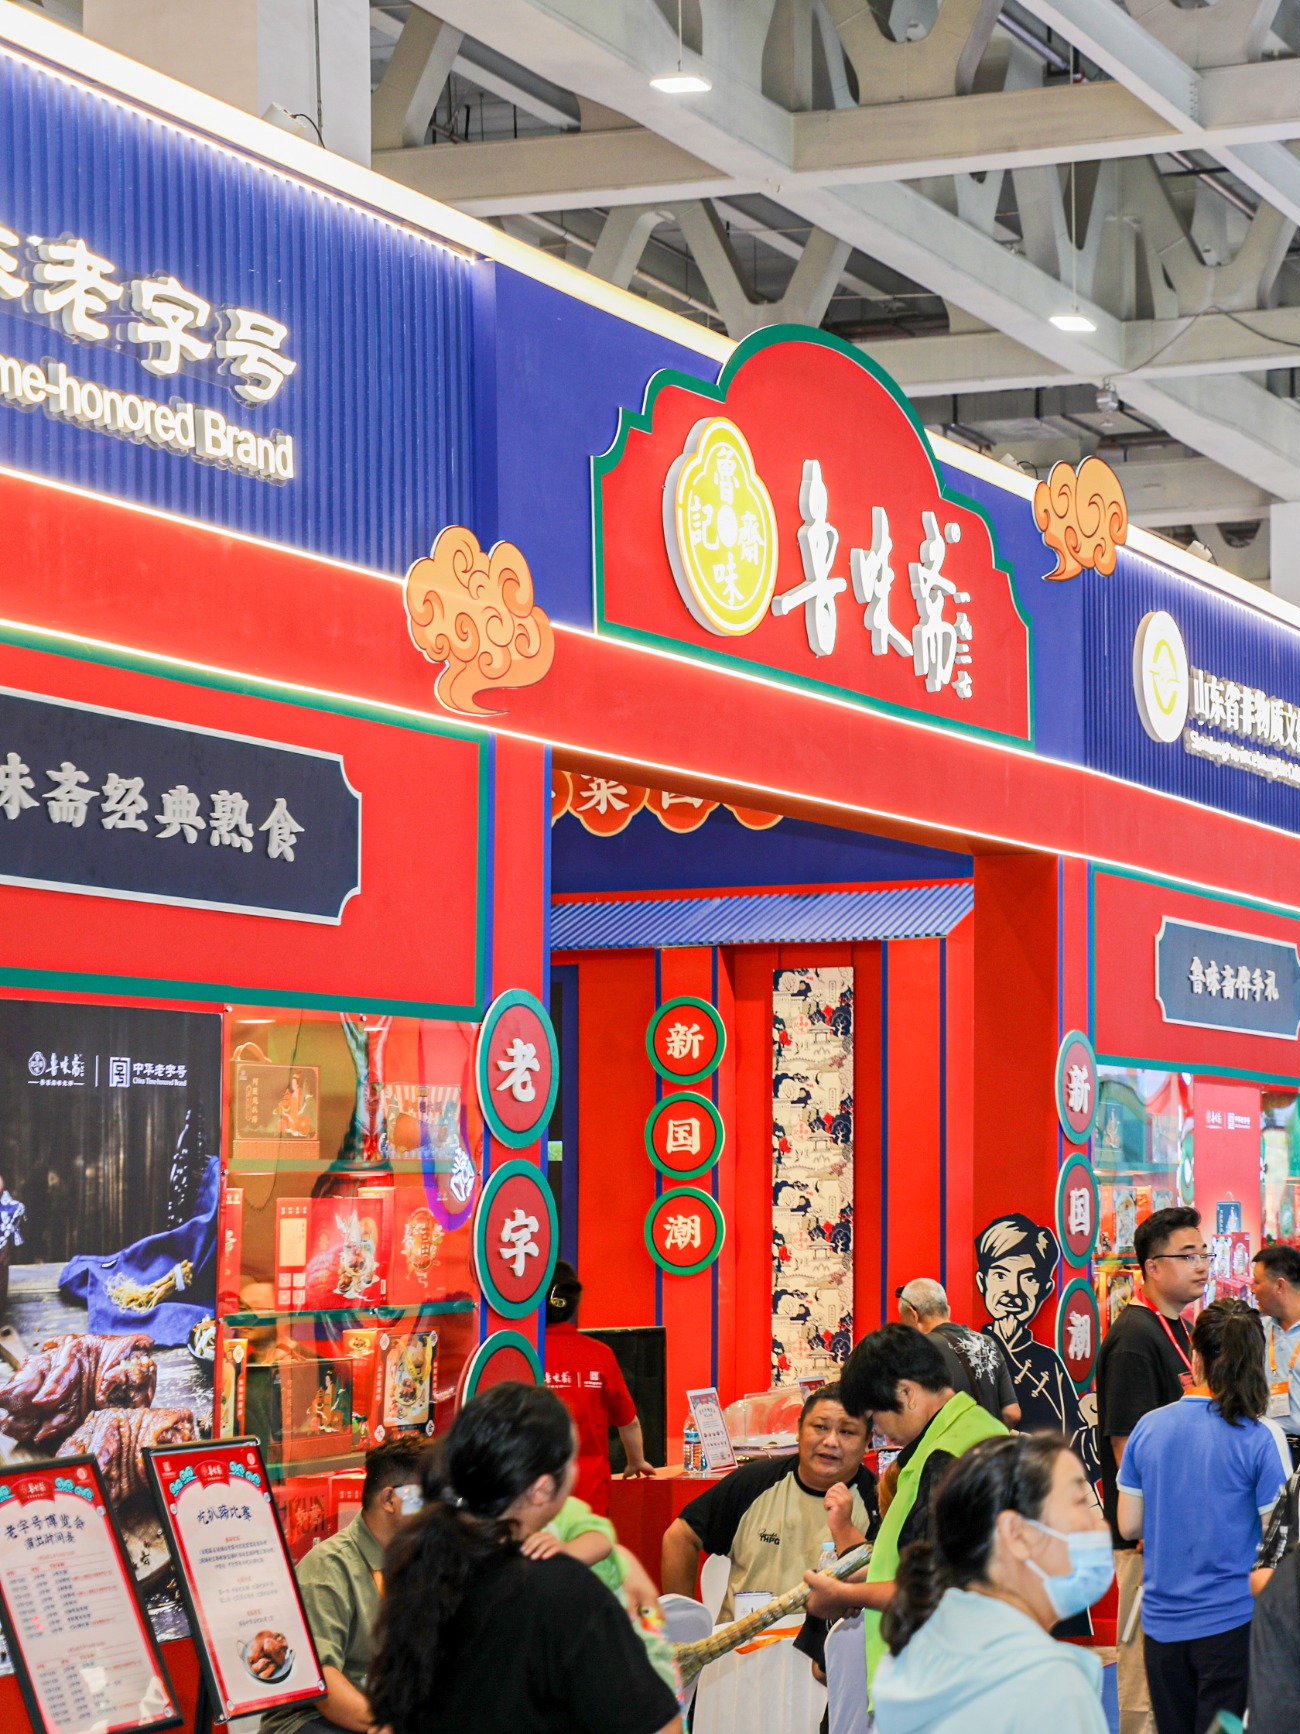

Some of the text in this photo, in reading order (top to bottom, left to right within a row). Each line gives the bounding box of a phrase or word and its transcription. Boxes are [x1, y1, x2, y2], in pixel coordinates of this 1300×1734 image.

[203, 411, 294, 479] Brand
[1188, 956, 1280, 1002] 鲁味斋伴手礼
[132, 1062, 188, 1079] 中华老字号
[5, 1514, 86, 1540] 老字号博览会
